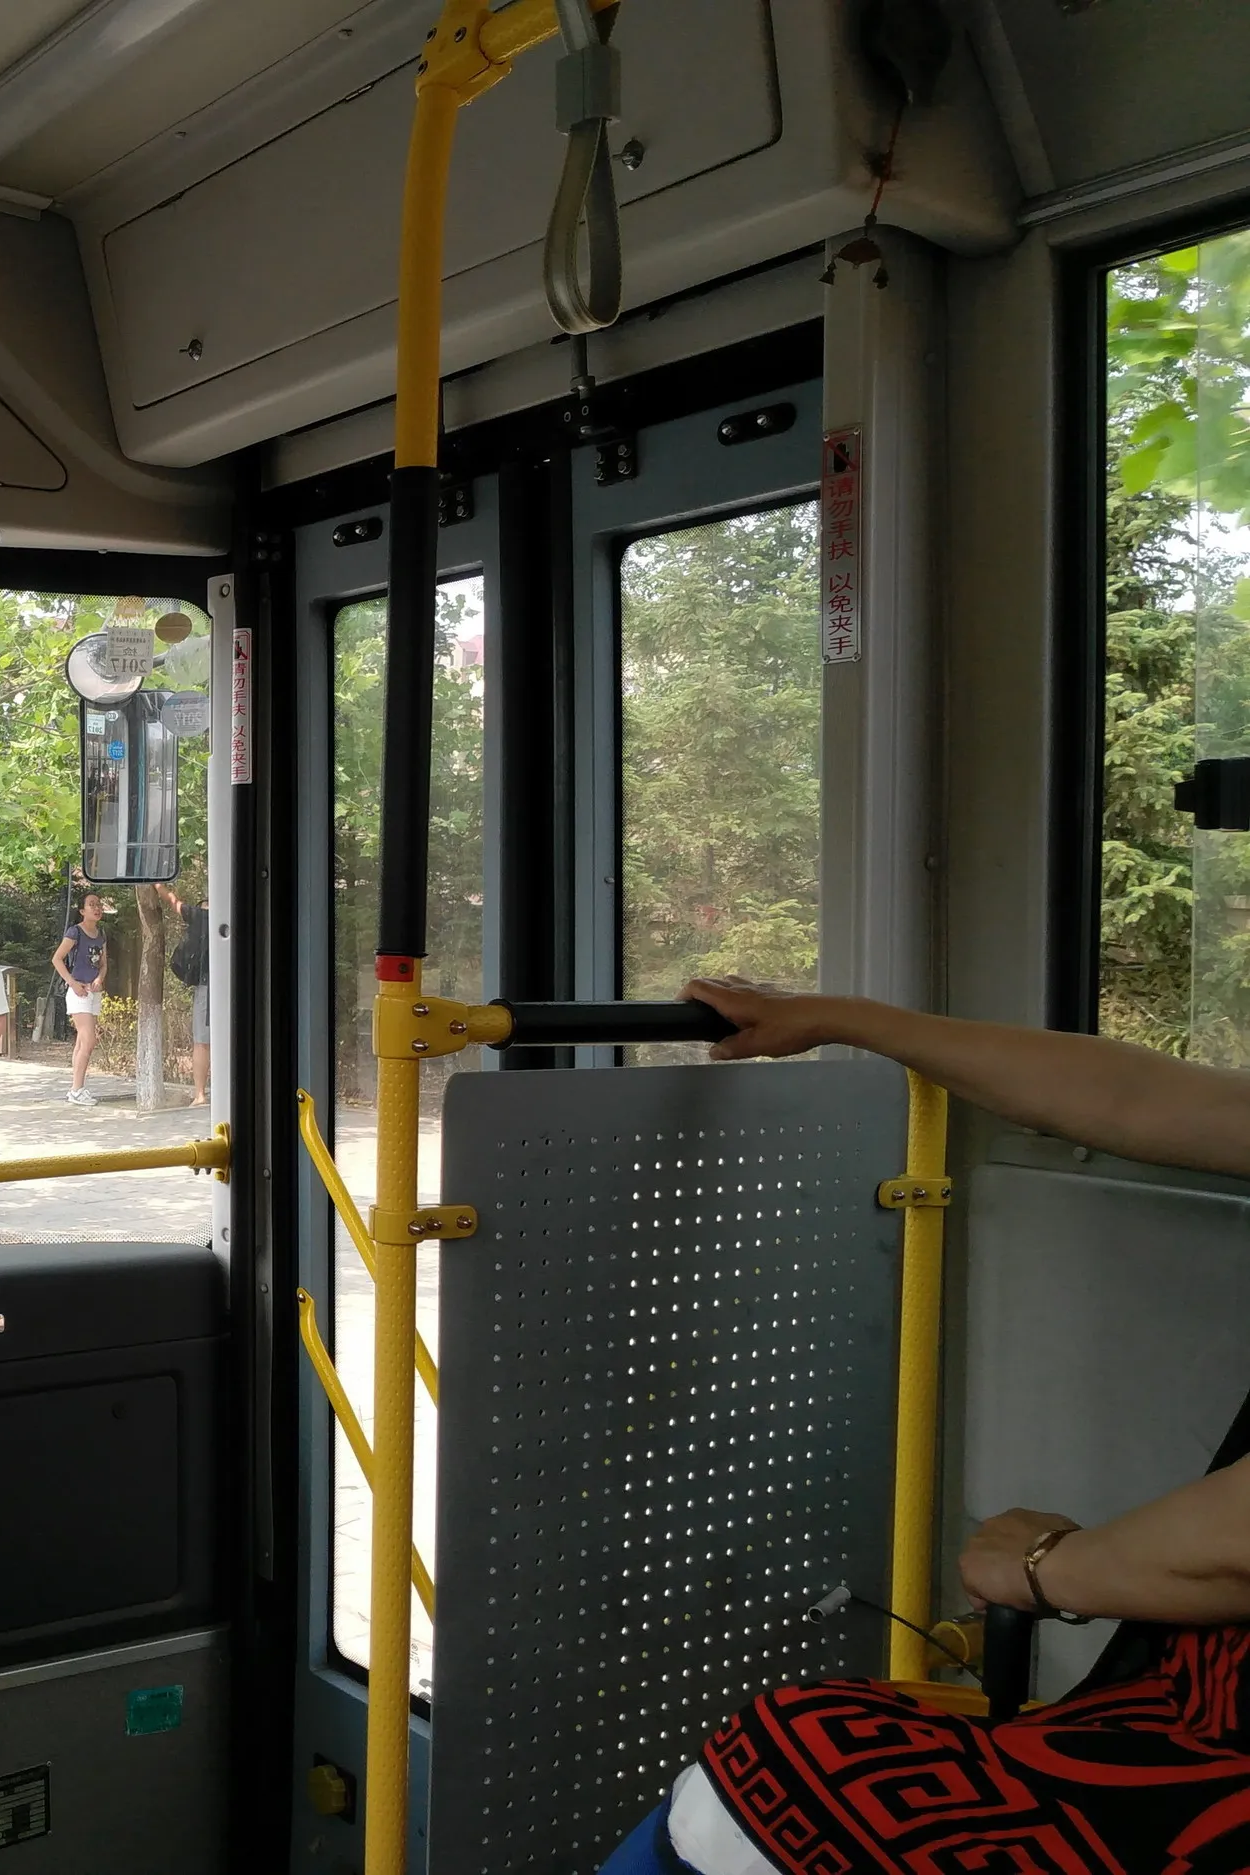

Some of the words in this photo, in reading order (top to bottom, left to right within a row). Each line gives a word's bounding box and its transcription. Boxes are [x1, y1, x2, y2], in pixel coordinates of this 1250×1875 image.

[827, 479, 855, 561] 请勿手扶
[827, 574, 854, 655] 以免夹手
